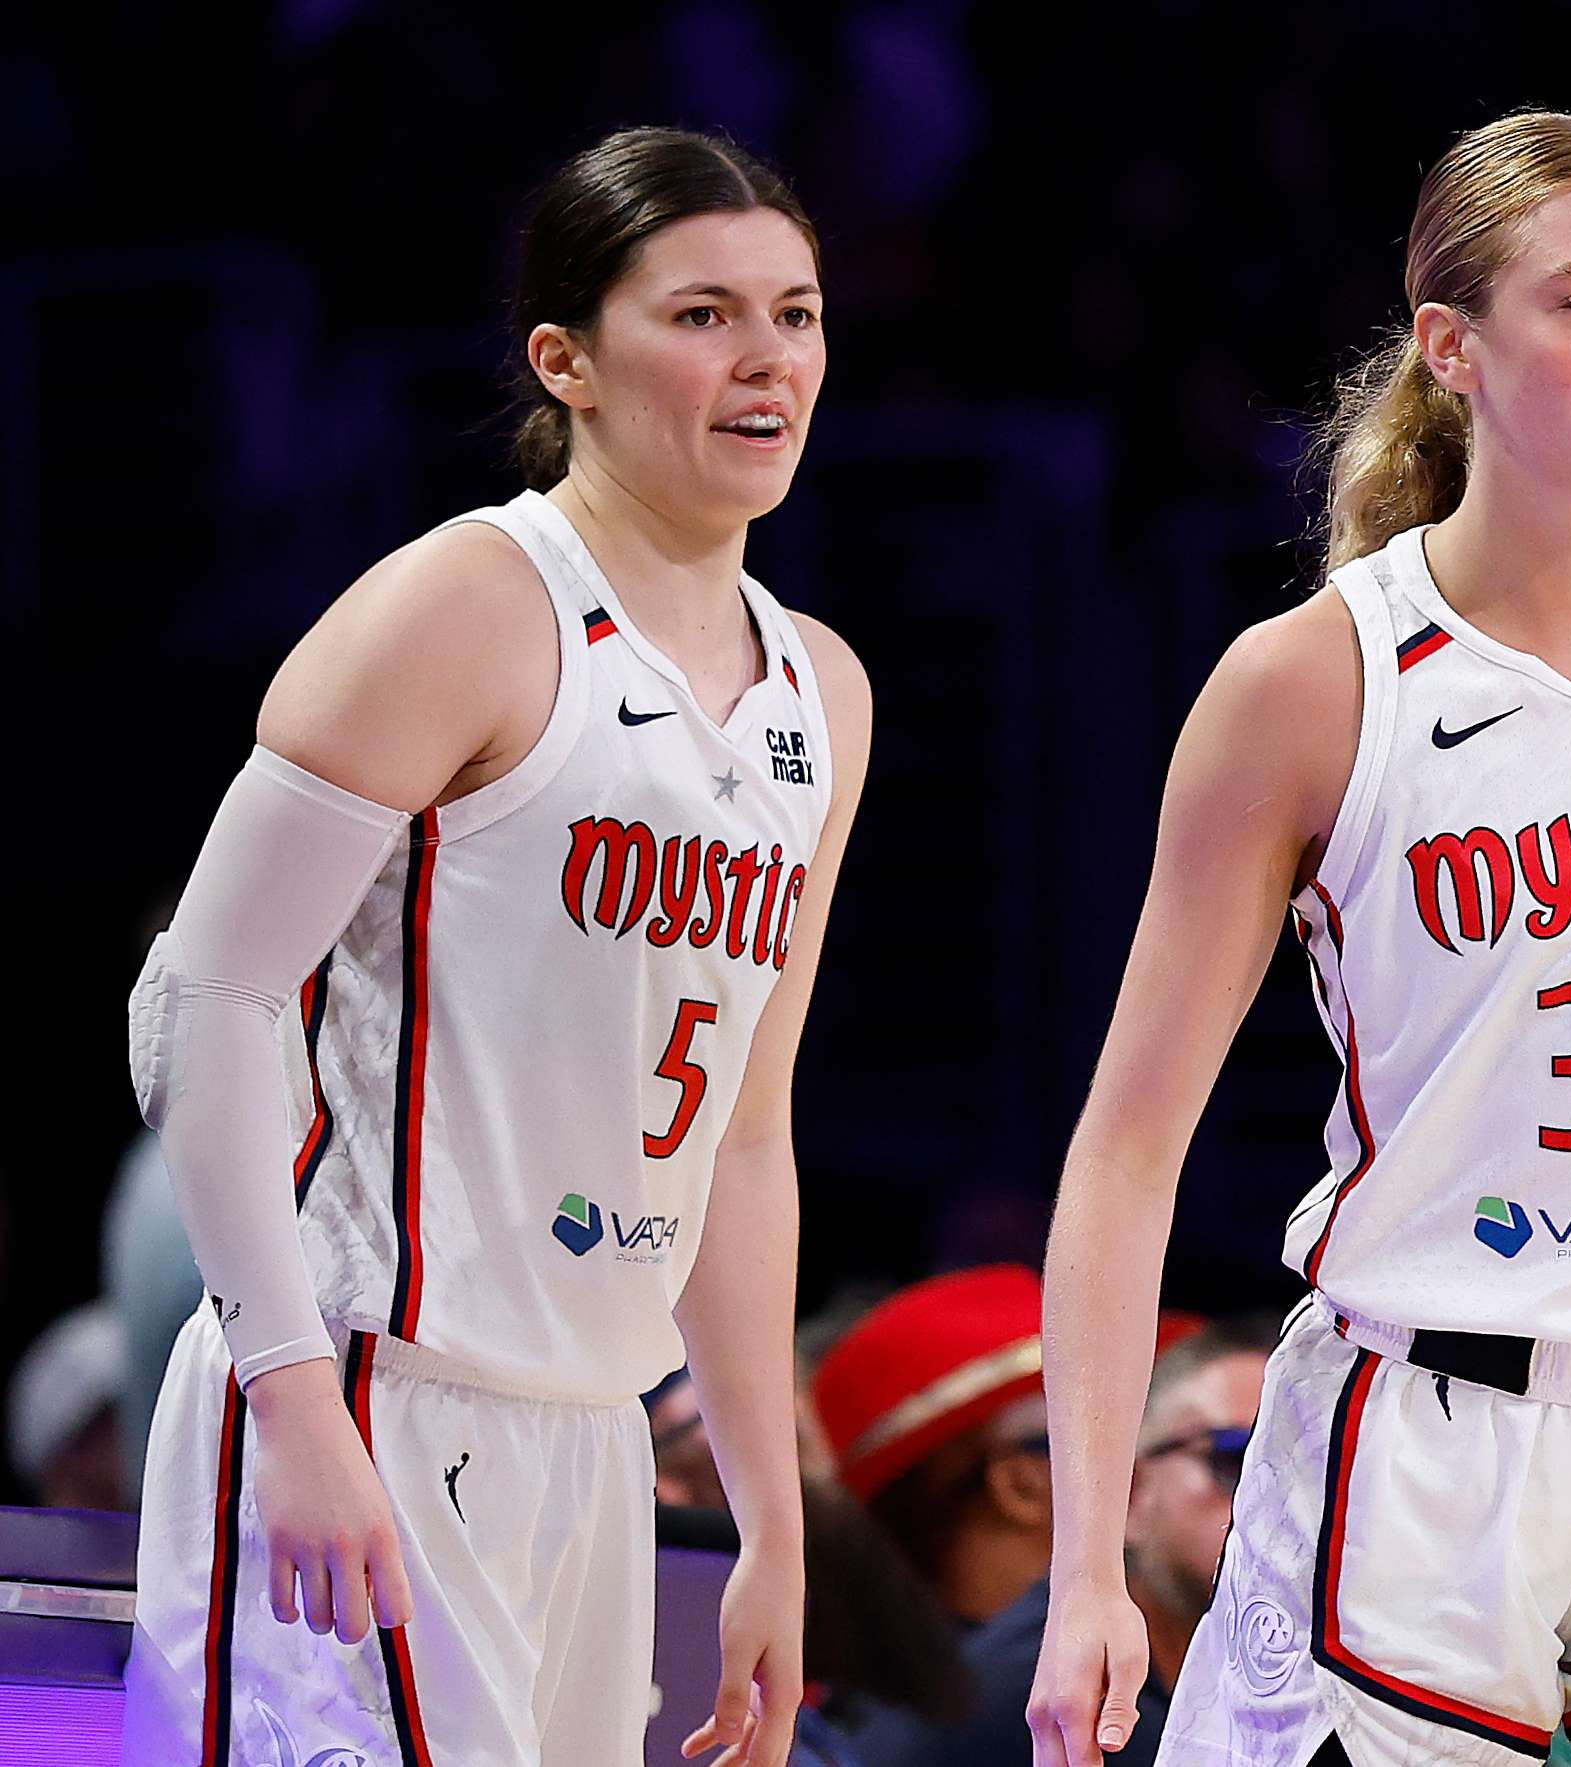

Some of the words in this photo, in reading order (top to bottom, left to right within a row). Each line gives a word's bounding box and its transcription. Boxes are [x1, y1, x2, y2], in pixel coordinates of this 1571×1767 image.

[765, 727, 806, 757] CAR
[771, 755, 814, 788] max
[560, 814, 806, 973] mystic
[642, 998, 718, 1160] 5
